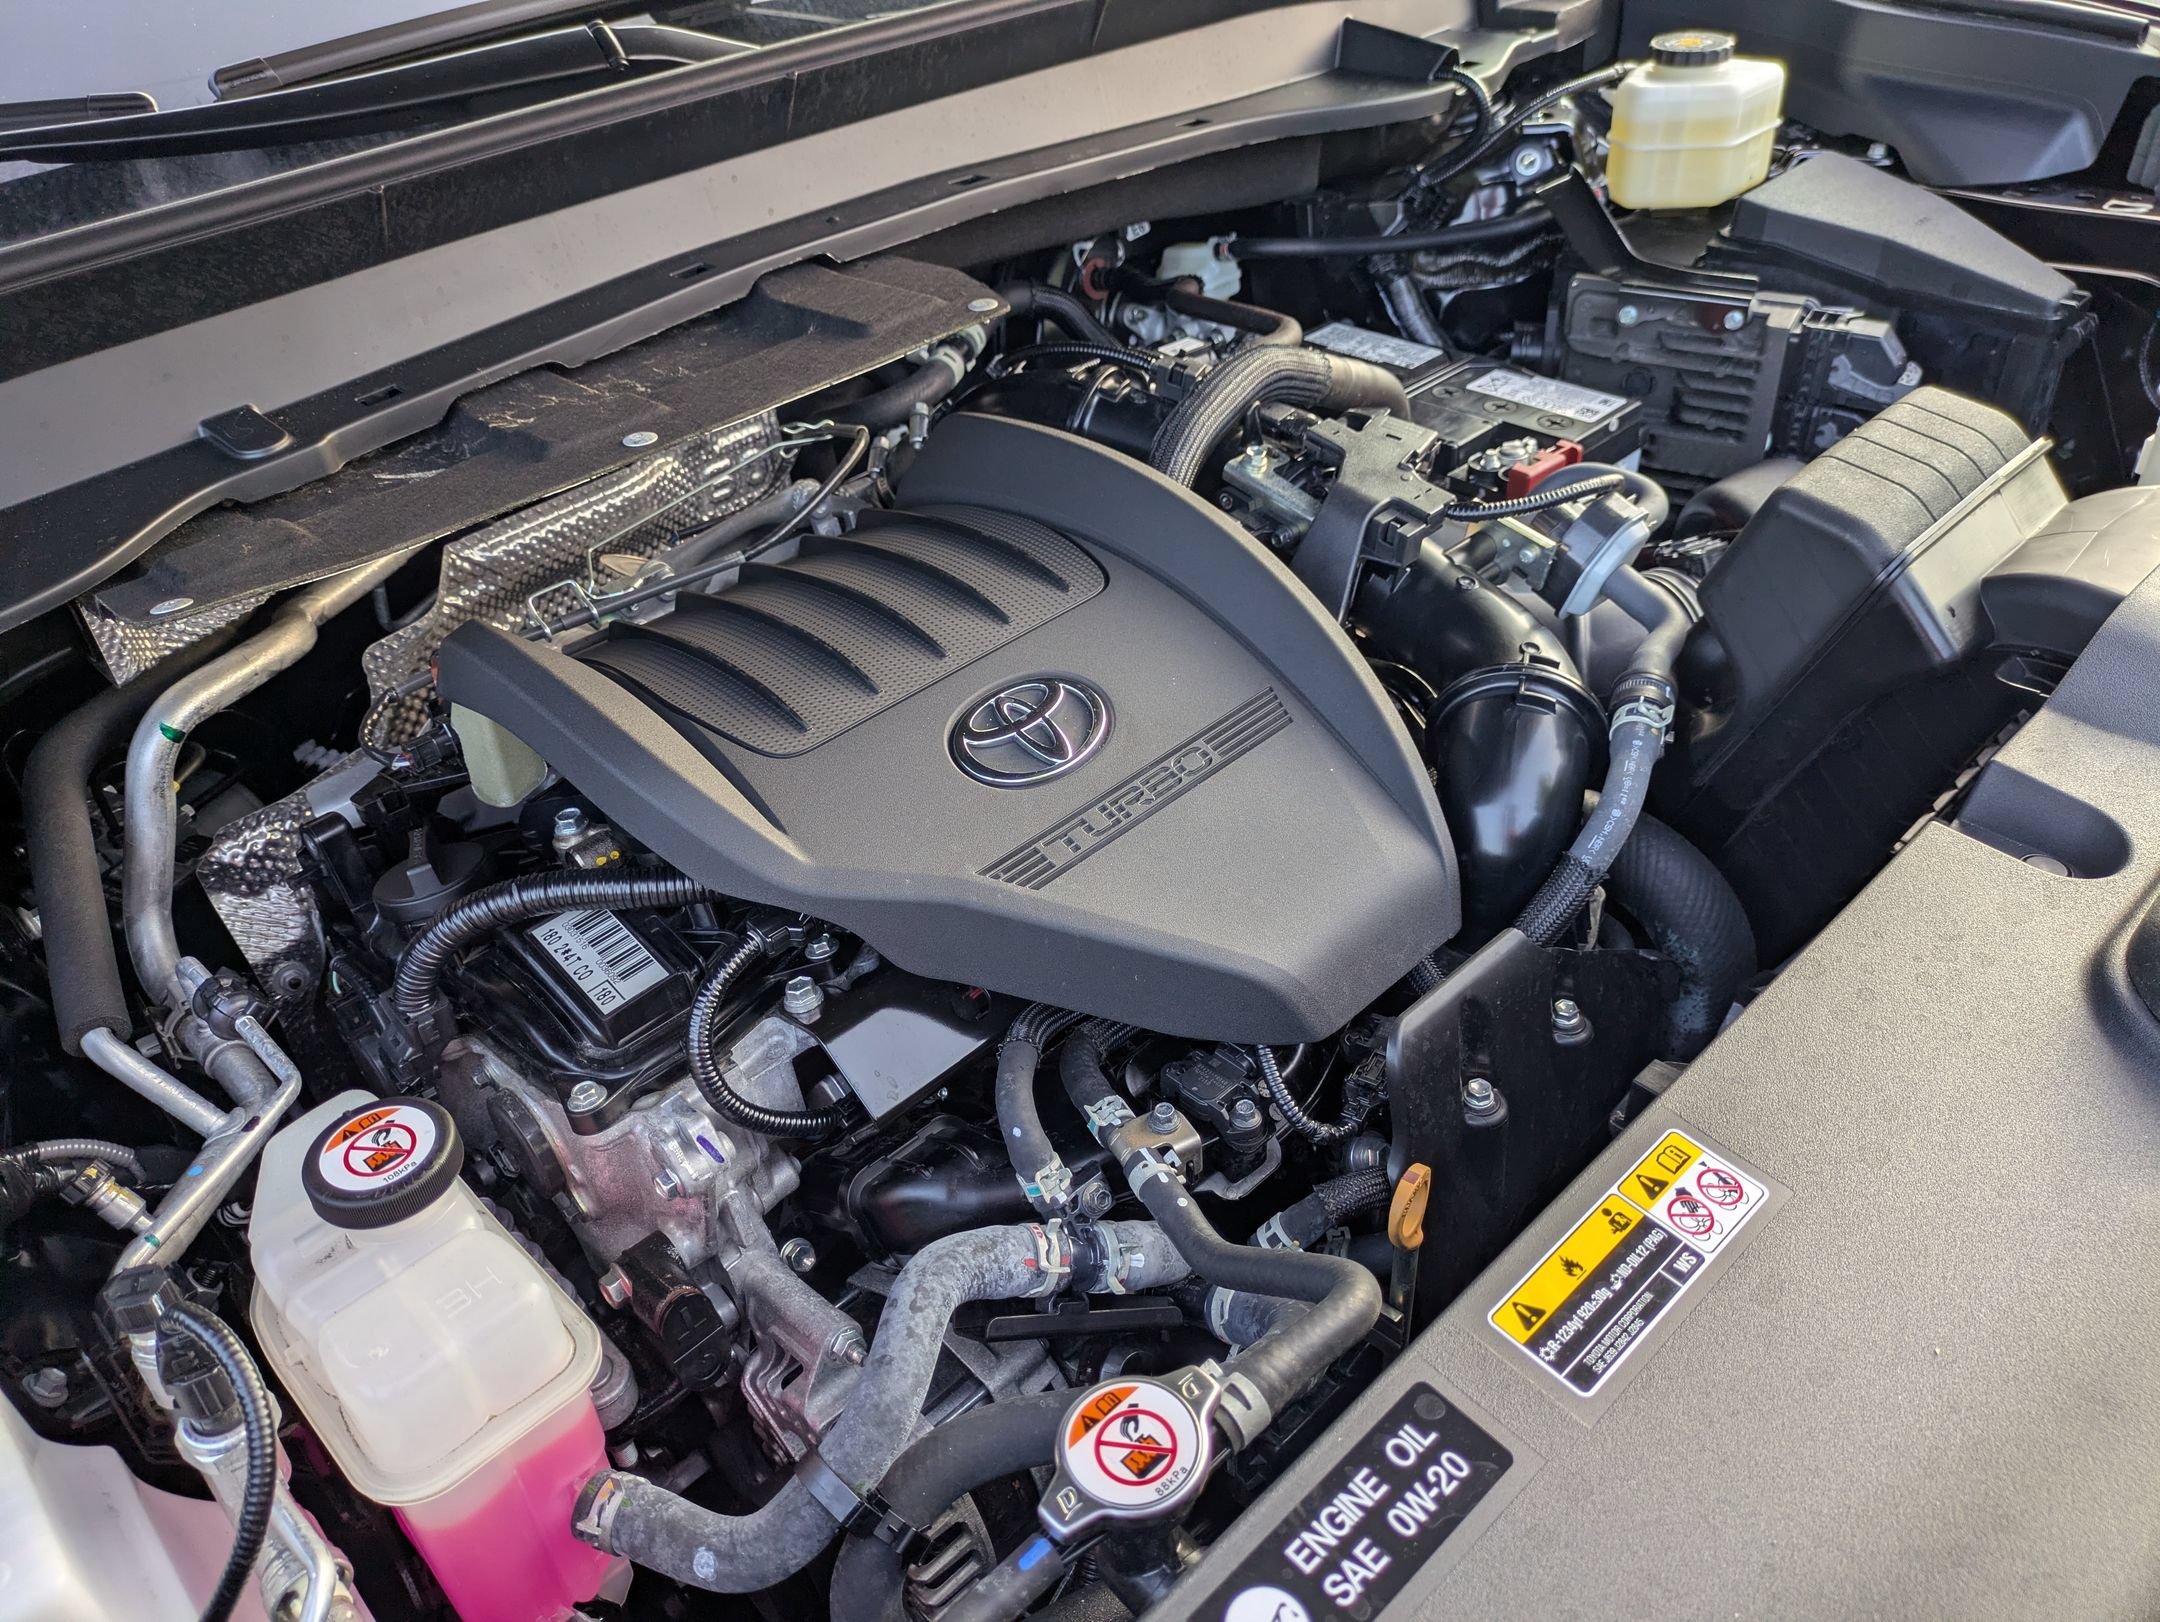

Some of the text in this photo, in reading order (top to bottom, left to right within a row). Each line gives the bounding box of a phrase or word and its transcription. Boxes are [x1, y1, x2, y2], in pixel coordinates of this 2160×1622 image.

[1041, 747, 1213, 853] TURBO
[541, 928, 563, 946] 180
[594, 987, 616, 1006] 180
[383, 1161, 417, 1183] 108kPa
[1673, 1252, 1698, 1273] WS
[1547, 1314, 1585, 1353] R-1234yf
[1576, 1287, 1614, 1320] 920±30g
[1642, 1227, 1669, 1252] (PAG)
[1583, 1292, 1654, 1367] TOYOTA MOTOR CORPORATION
[1592, 1358, 1608, 1375] SAE
[1155, 1466, 1189, 1497] 88kPa
[1283, 1423, 1440, 1575] ENGINE OIL
[1322, 1450, 1472, 1607] SAE 0W-20
